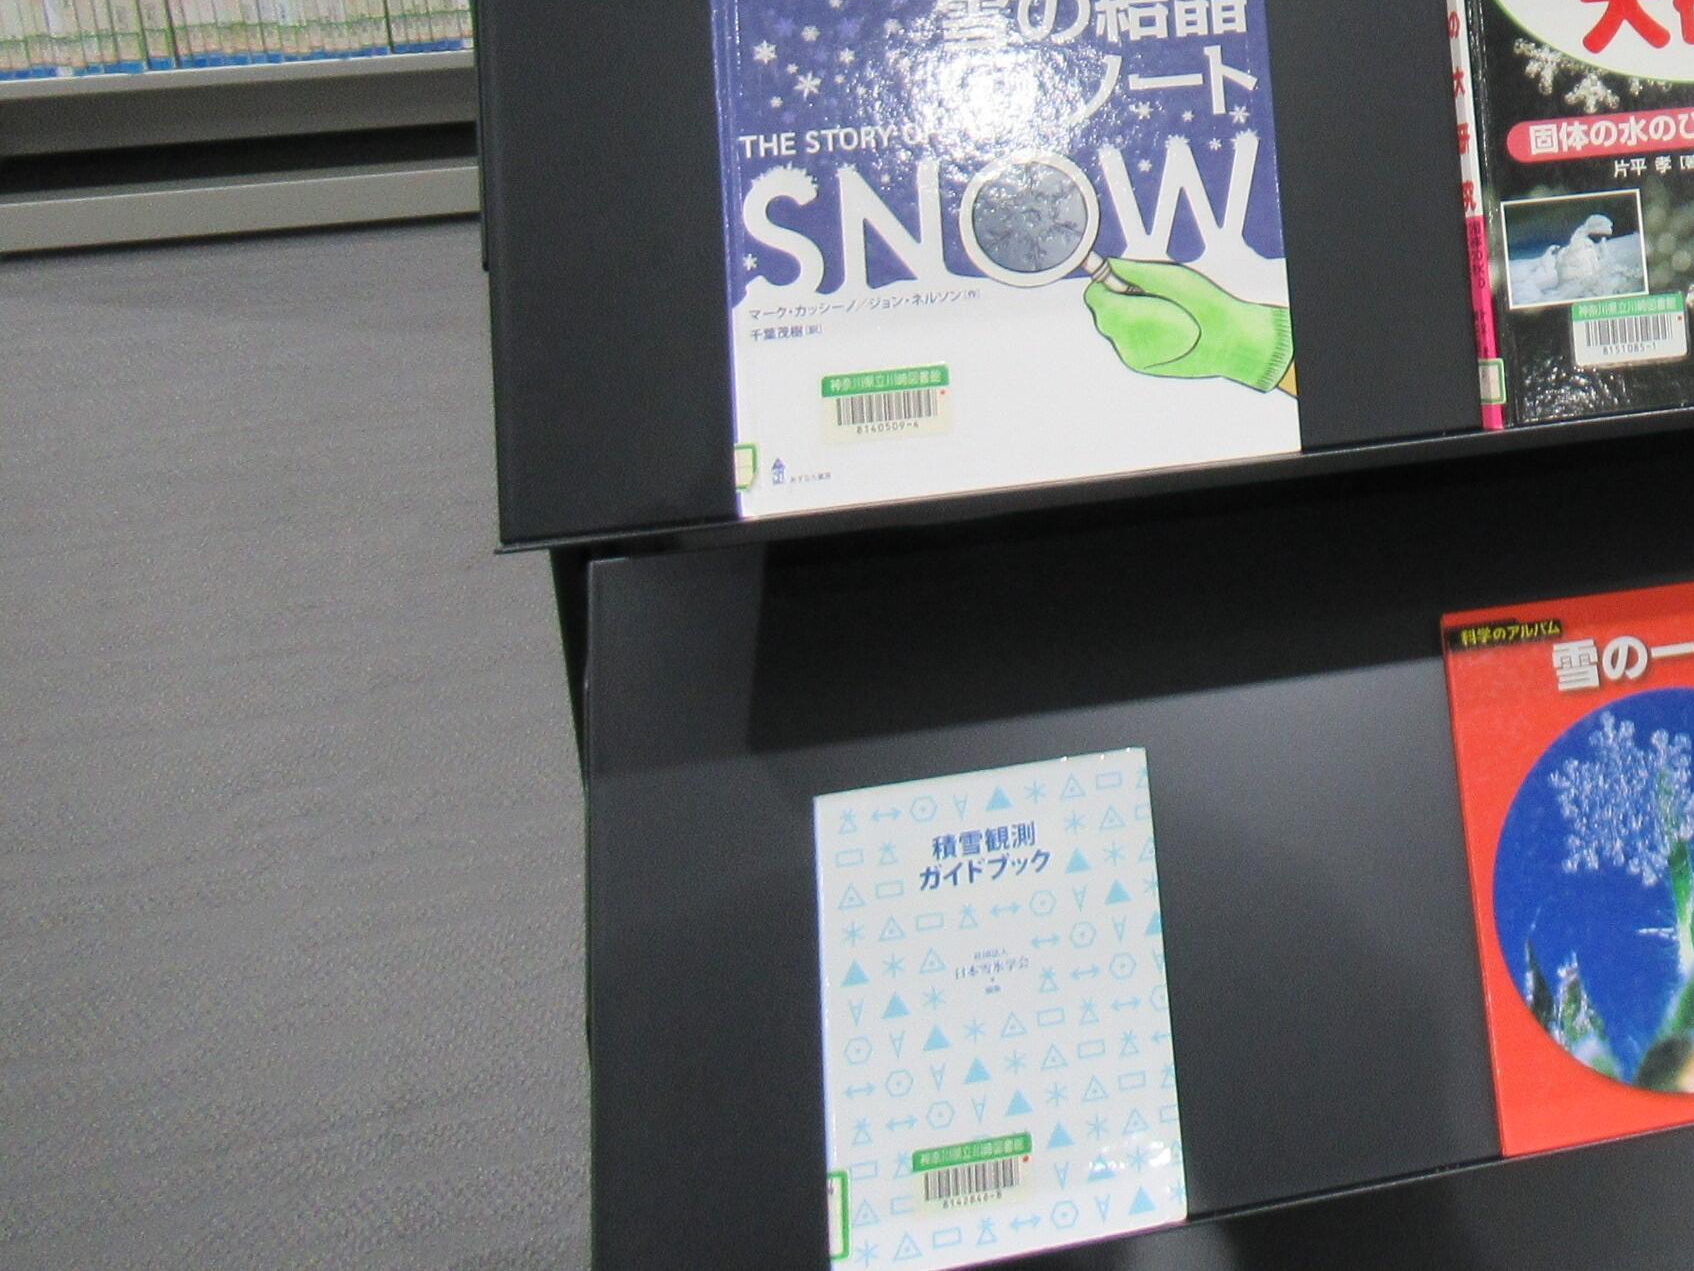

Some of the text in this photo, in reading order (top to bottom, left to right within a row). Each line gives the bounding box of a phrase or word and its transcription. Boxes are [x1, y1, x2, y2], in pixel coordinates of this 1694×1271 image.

[741, 133, 797, 158] THE
[805, 127, 890, 154] STORY
[742, 132, 1260, 292] SNOW
[1603, 342, 1657, 355] 8151085-1
[856, 421, 919, 434] 8140509-4
[1460, 619, 1561, 646] 科学のアルバム
[932, 821, 1037, 861] 積雪観測
[919, 848, 1051, 892] ガイドブック
